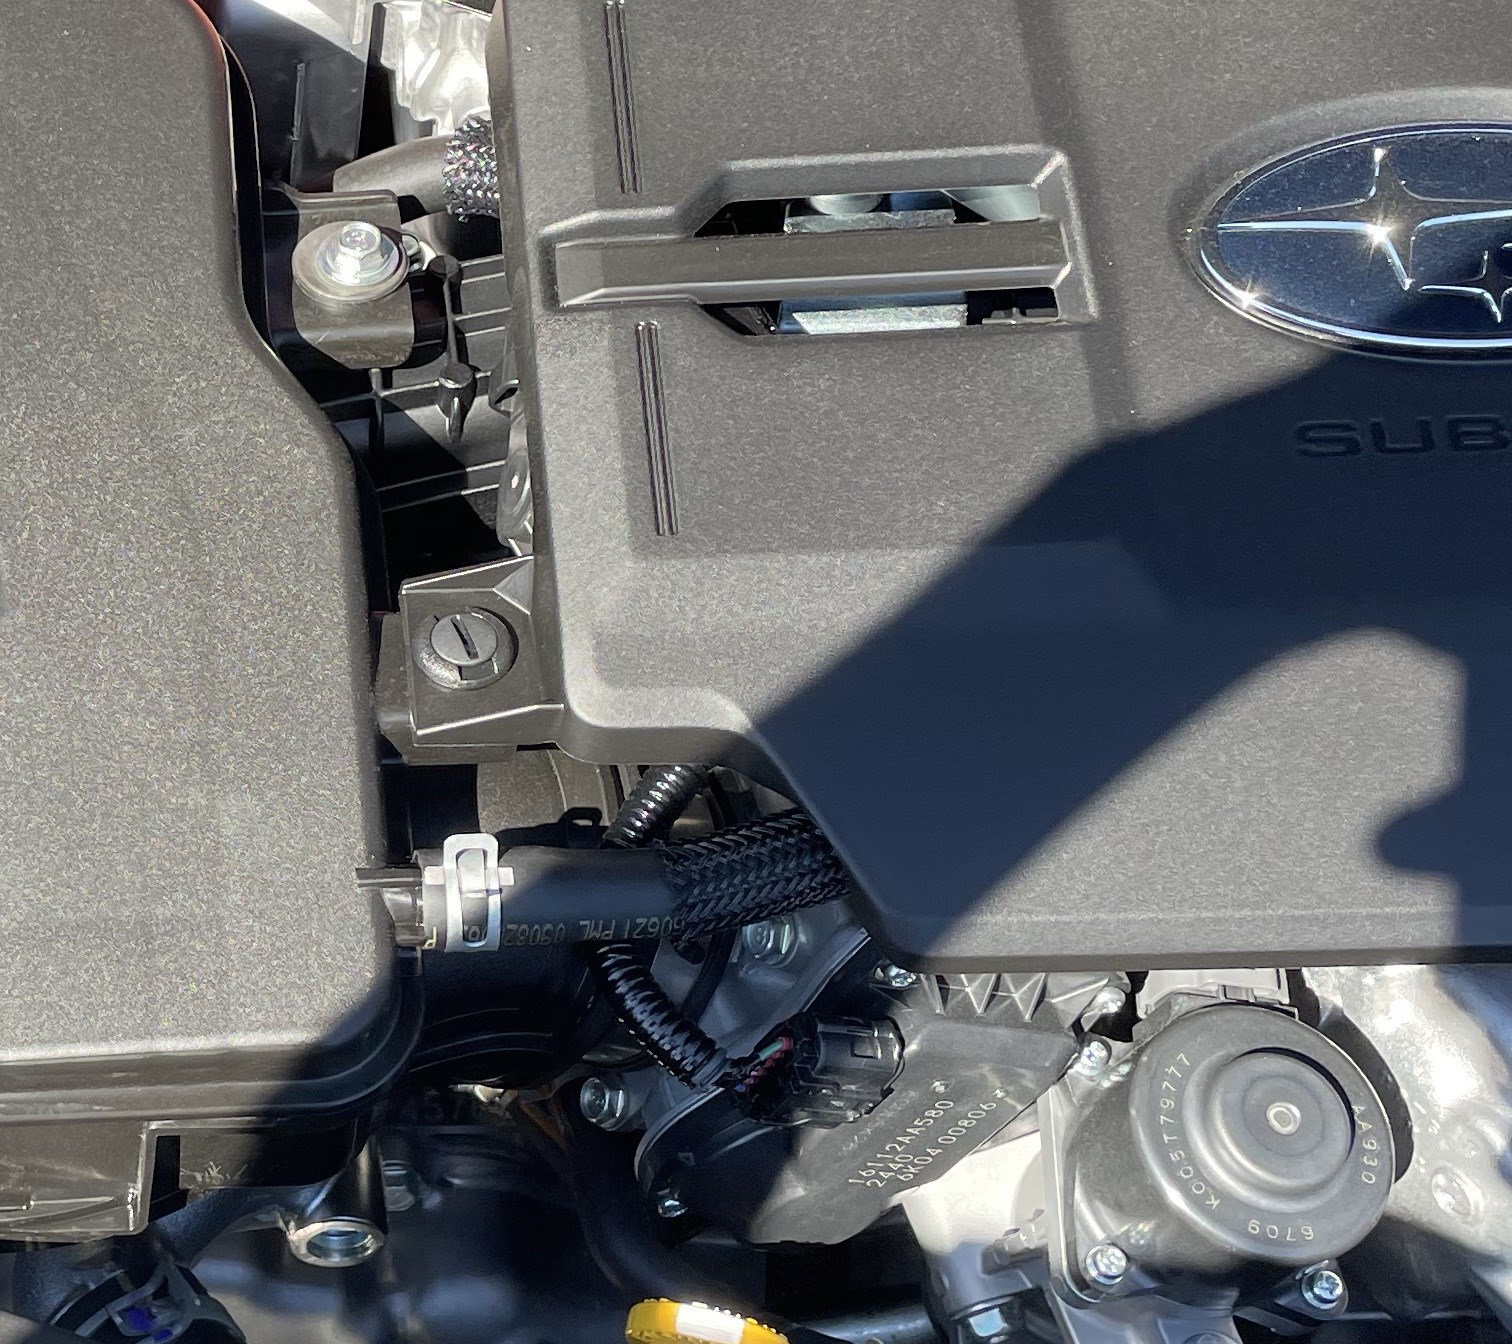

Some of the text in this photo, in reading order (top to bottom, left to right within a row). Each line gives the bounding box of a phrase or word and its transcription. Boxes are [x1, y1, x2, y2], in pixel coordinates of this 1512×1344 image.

[848, 1100, 954, 1183] 16112AA580
[937, 1102, 997, 1145] 00806
[866, 1154, 914, 1188] 2440
[1248, 1218, 1315, 1242] 6709
